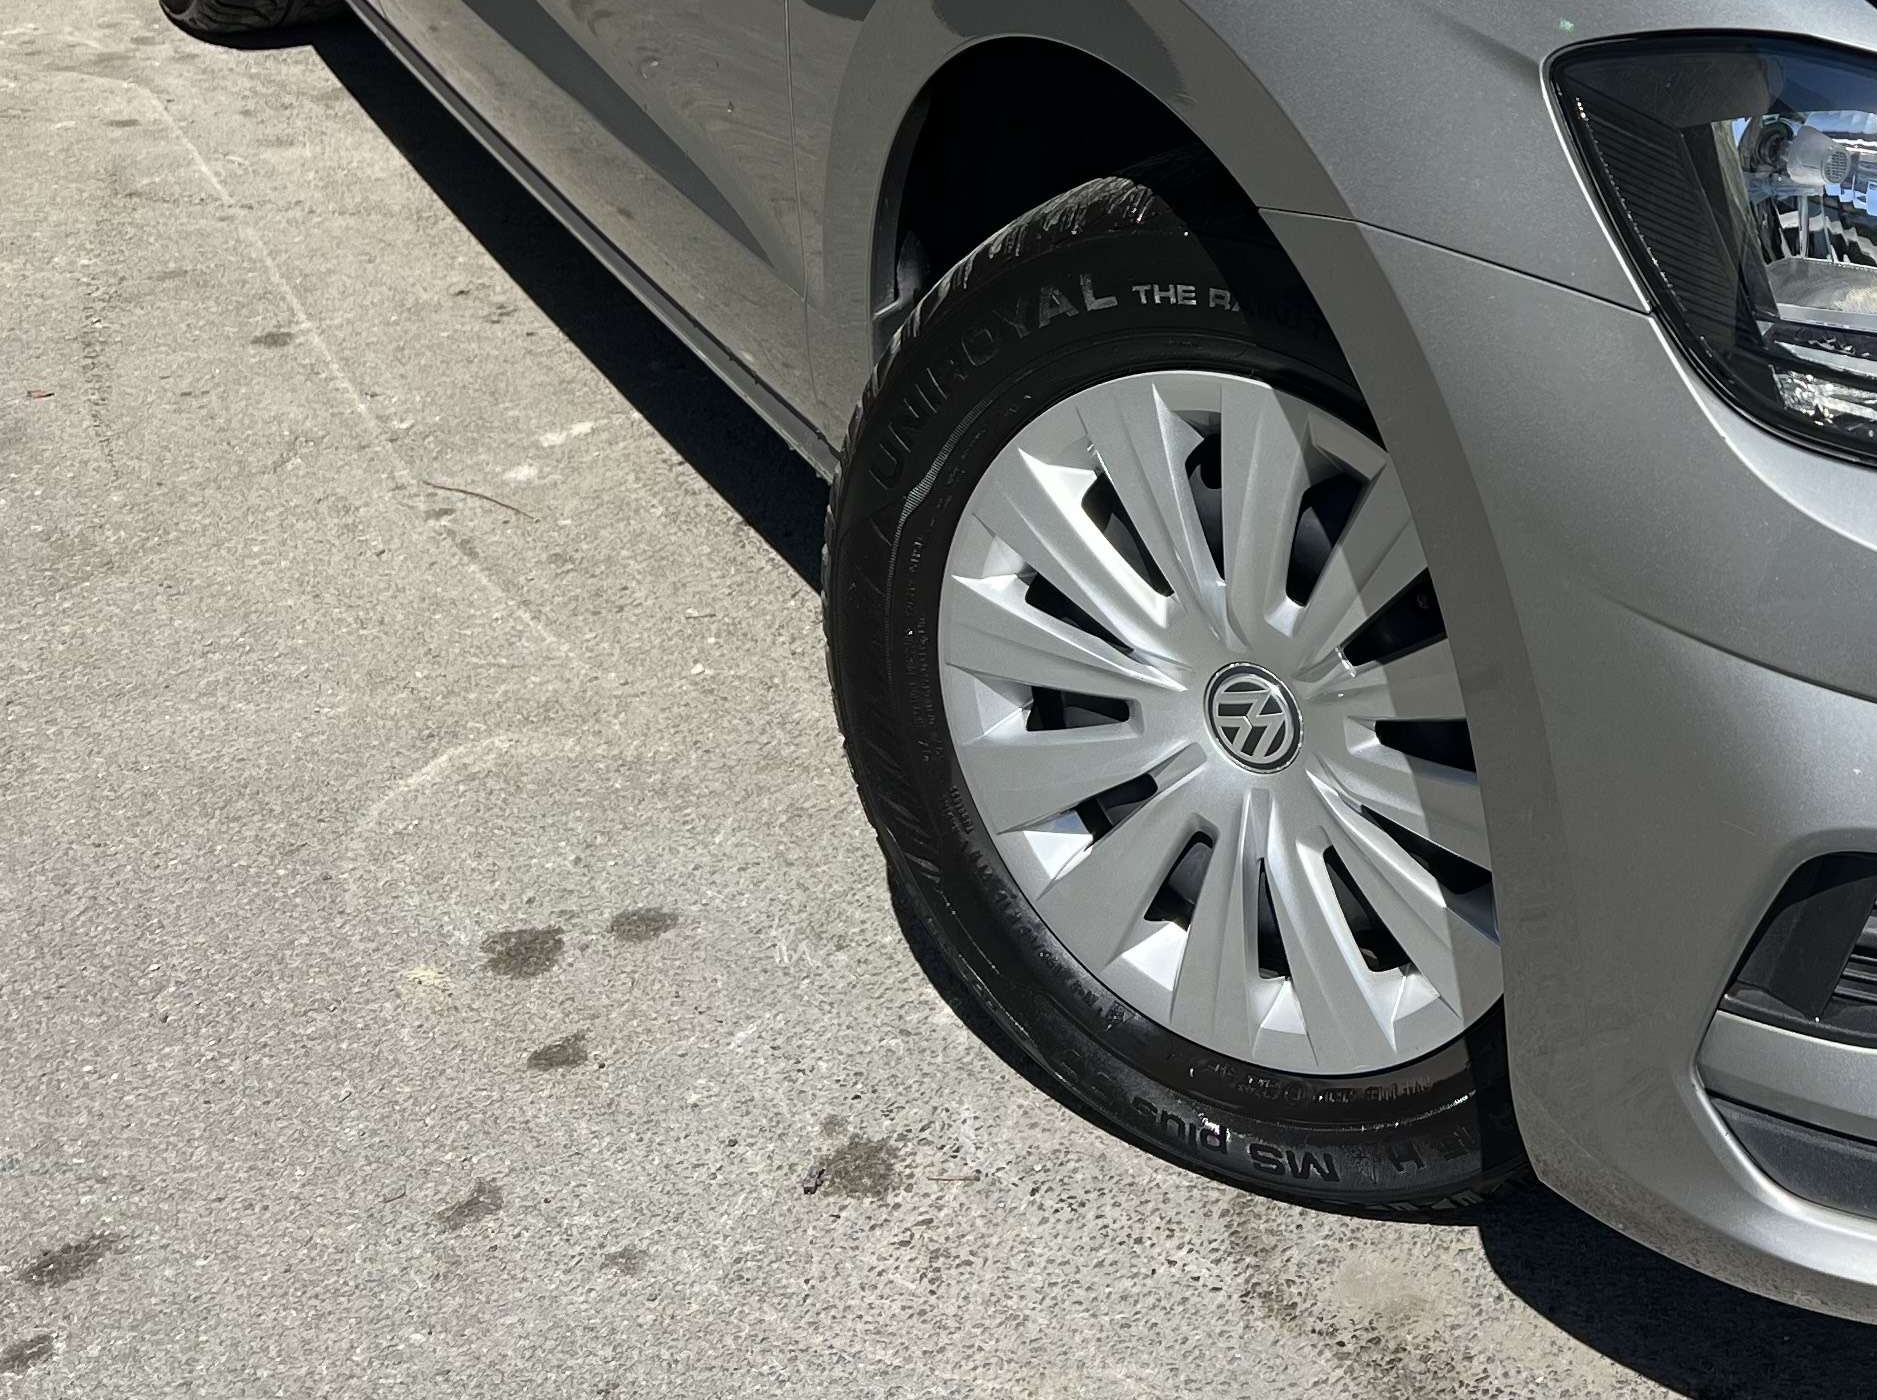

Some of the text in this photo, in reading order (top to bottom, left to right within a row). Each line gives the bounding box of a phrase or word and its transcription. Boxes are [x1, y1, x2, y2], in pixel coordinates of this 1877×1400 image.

[867, 273, 1119, 491] UNIROYAL
[1131, 283, 1198, 306] THE
[1130, 1096, 1228, 1155] plus
[1247, 1141, 1341, 1182] MS
